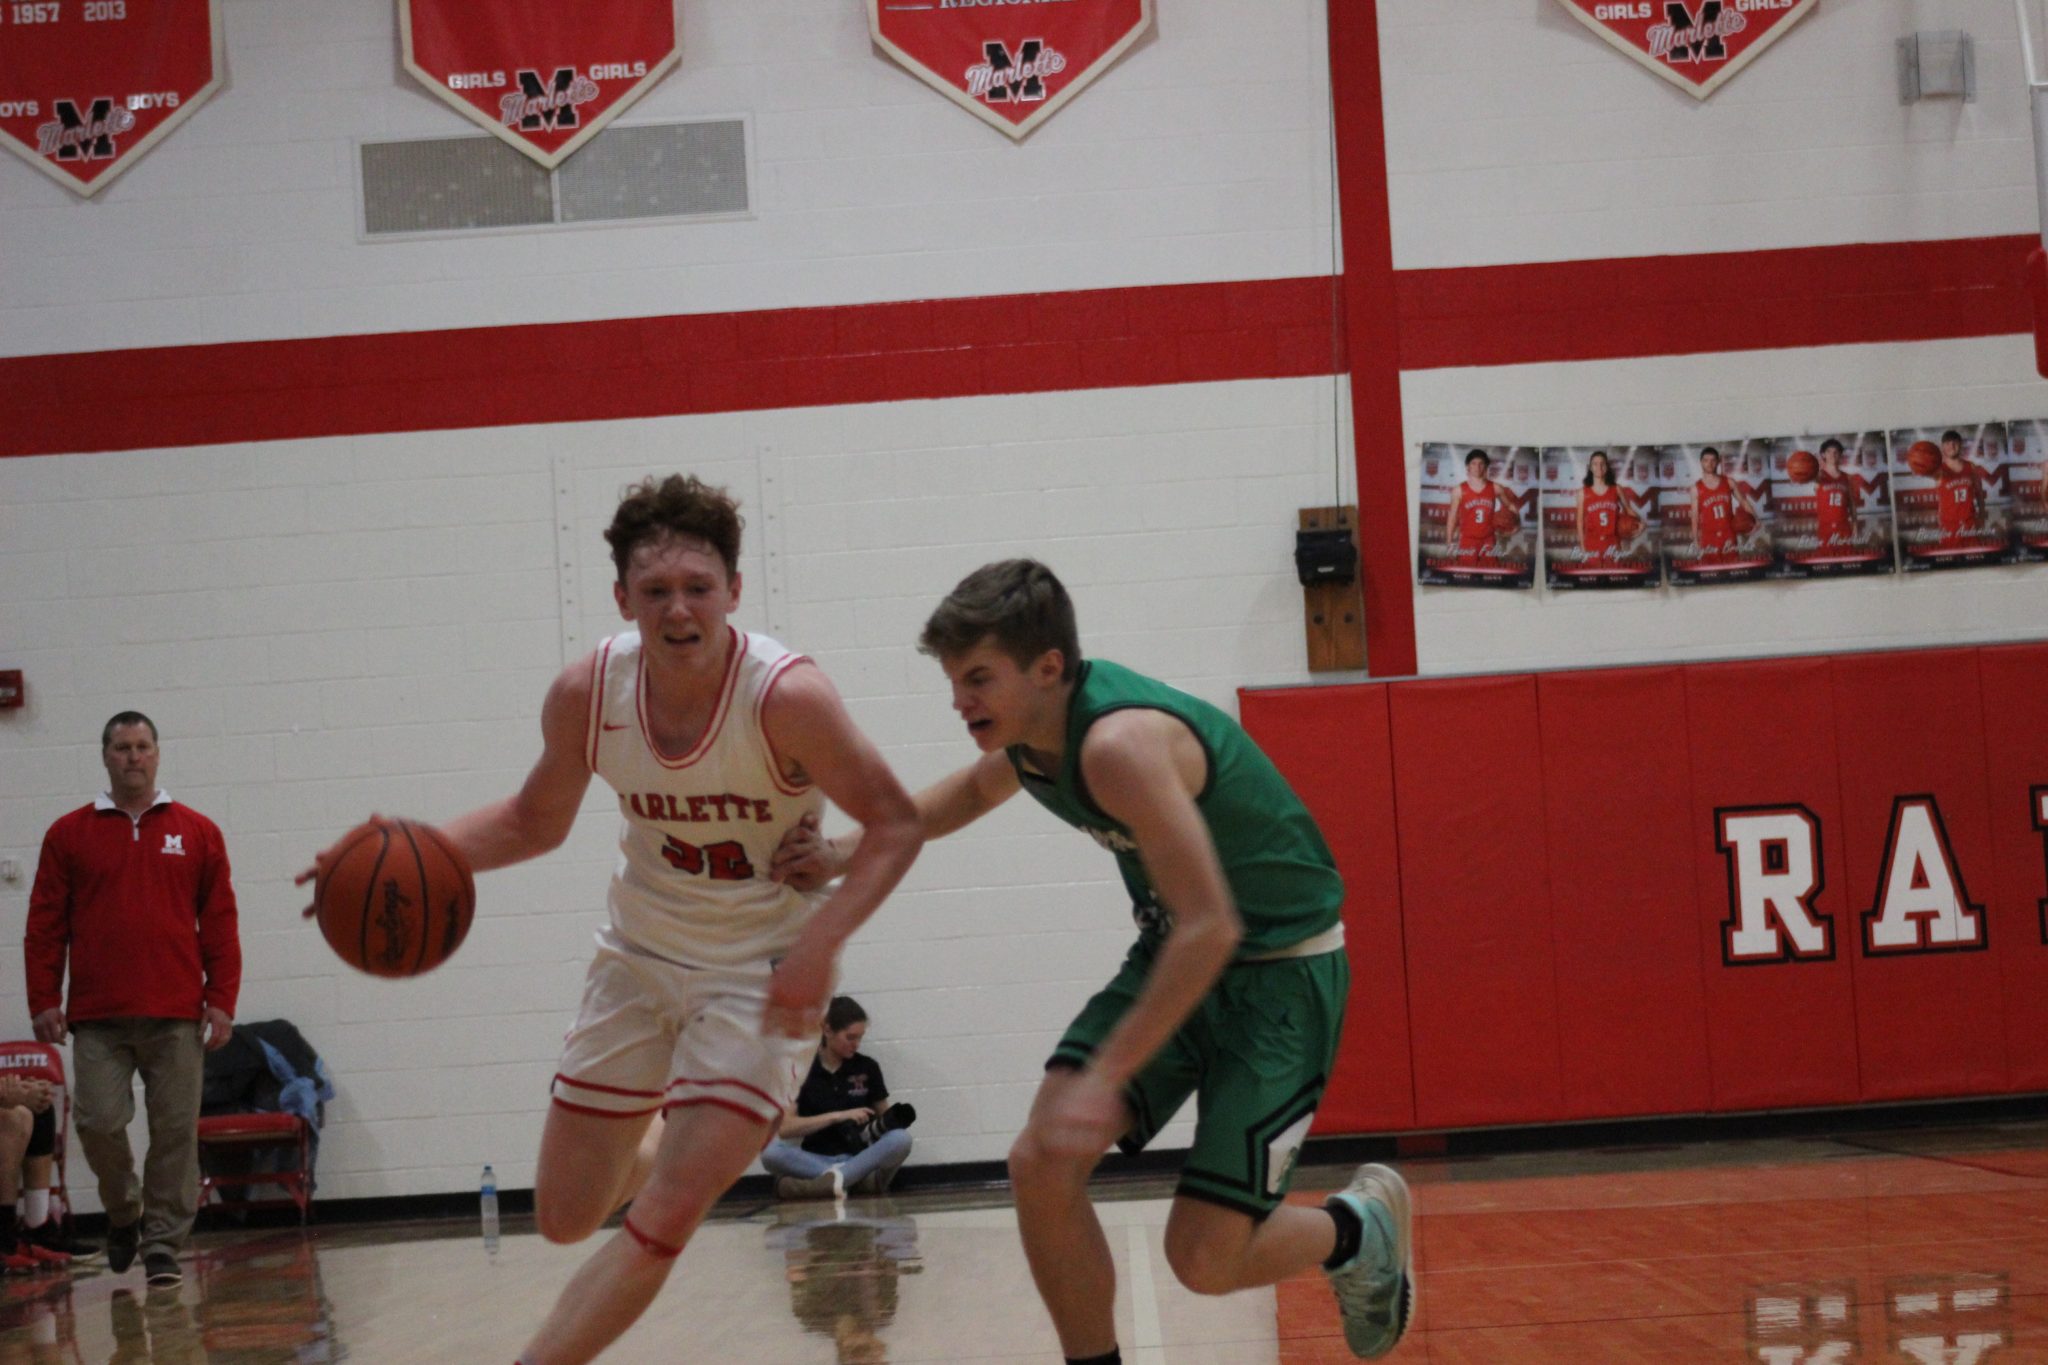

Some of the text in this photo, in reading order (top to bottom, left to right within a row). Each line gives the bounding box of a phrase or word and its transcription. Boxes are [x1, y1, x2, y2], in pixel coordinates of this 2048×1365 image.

[13, 1, 126, 24] 1957 2013
[1595, 3, 1651, 20] GIRLS
[1647, 8, 1747, 57] Marlette
[448, 71, 506, 89] GIRLS
[589, 62, 647, 80] GIRLS
[965, 48, 1066, 97] Marlette
[0, 102, 39, 117] OYS
[127, 92, 179, 110] BOYS
[499, 76, 599, 126] Marlette
[37, 106, 136, 157] Marlette
[1475, 508, 1485, 524] 3
[1599, 511, 1609, 527] 5
[619, 793, 773, 823] ARLETTE
[0, 1053, 48, 1068] RLETTE
